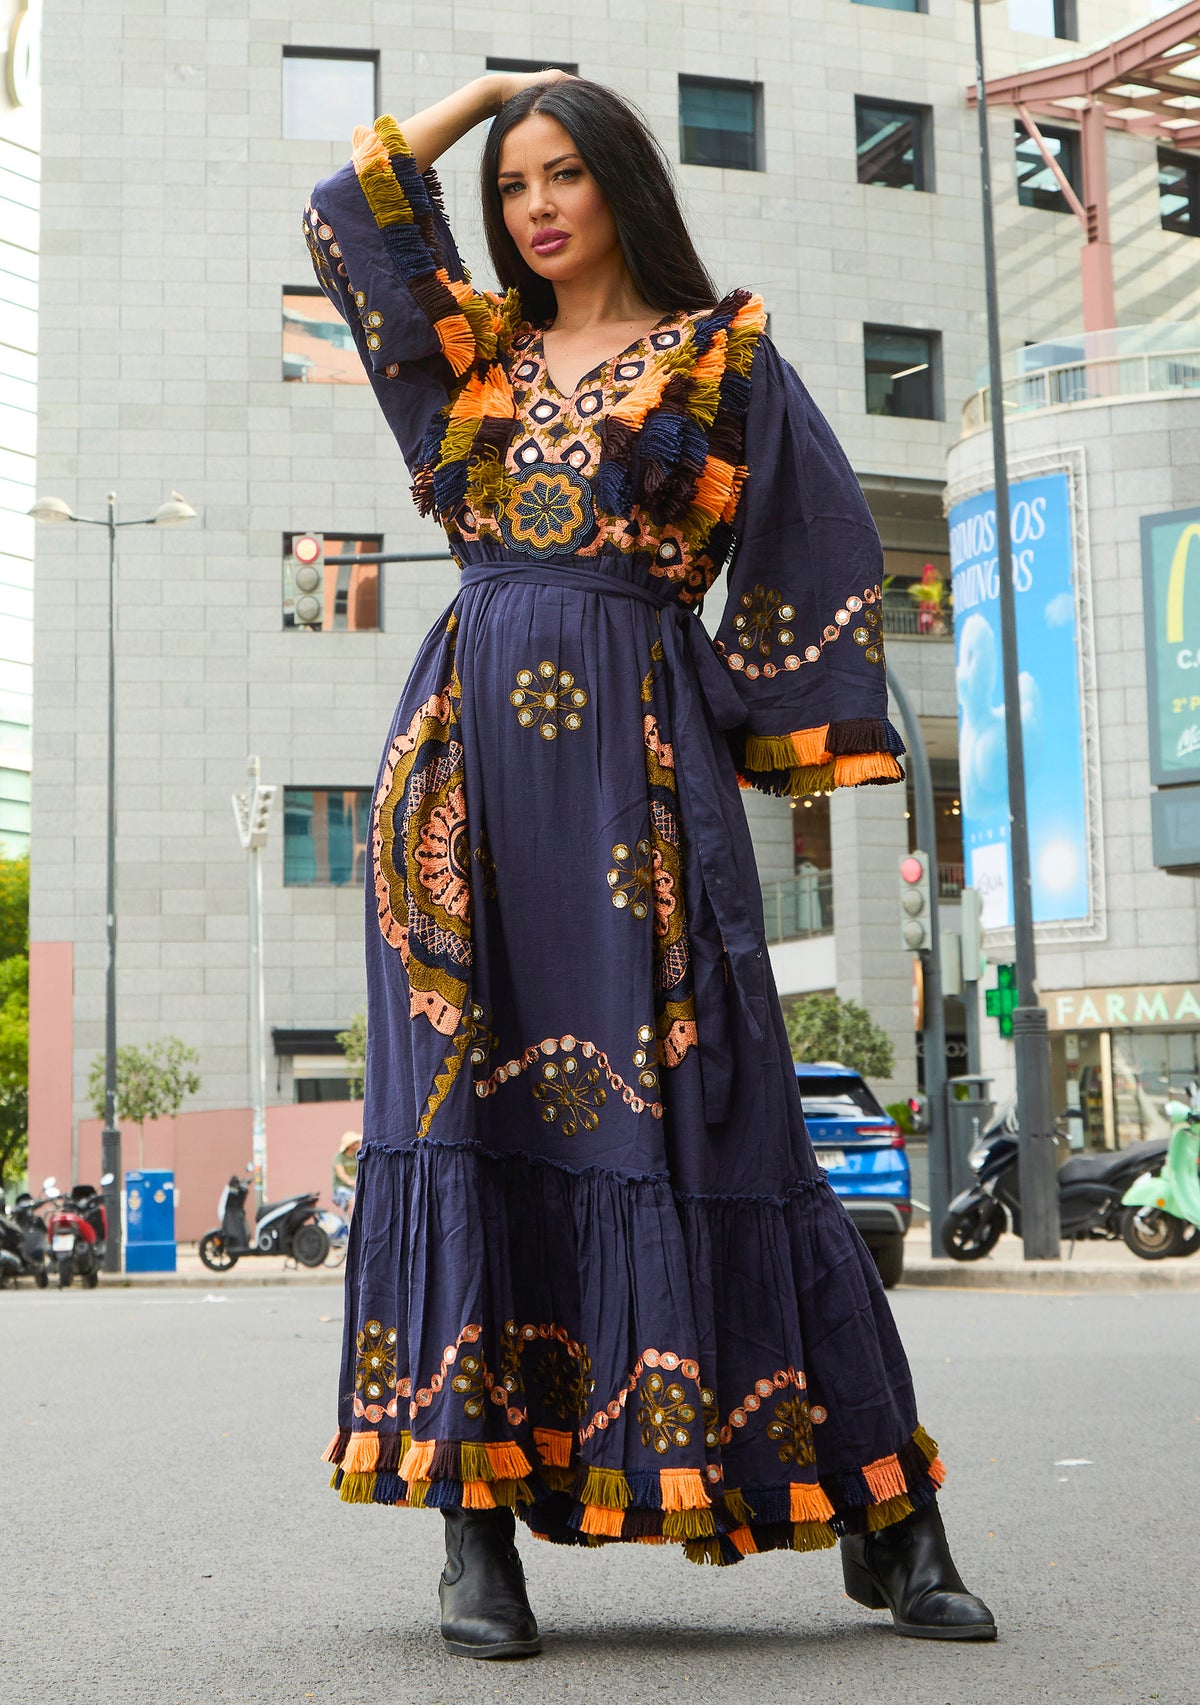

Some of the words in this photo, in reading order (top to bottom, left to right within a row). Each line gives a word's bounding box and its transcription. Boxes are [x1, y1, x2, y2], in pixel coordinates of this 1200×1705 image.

[1010, 497, 1046, 543] OS
[1176, 648, 1200, 669] C.
[1056, 989, 1200, 1025] FARMA
